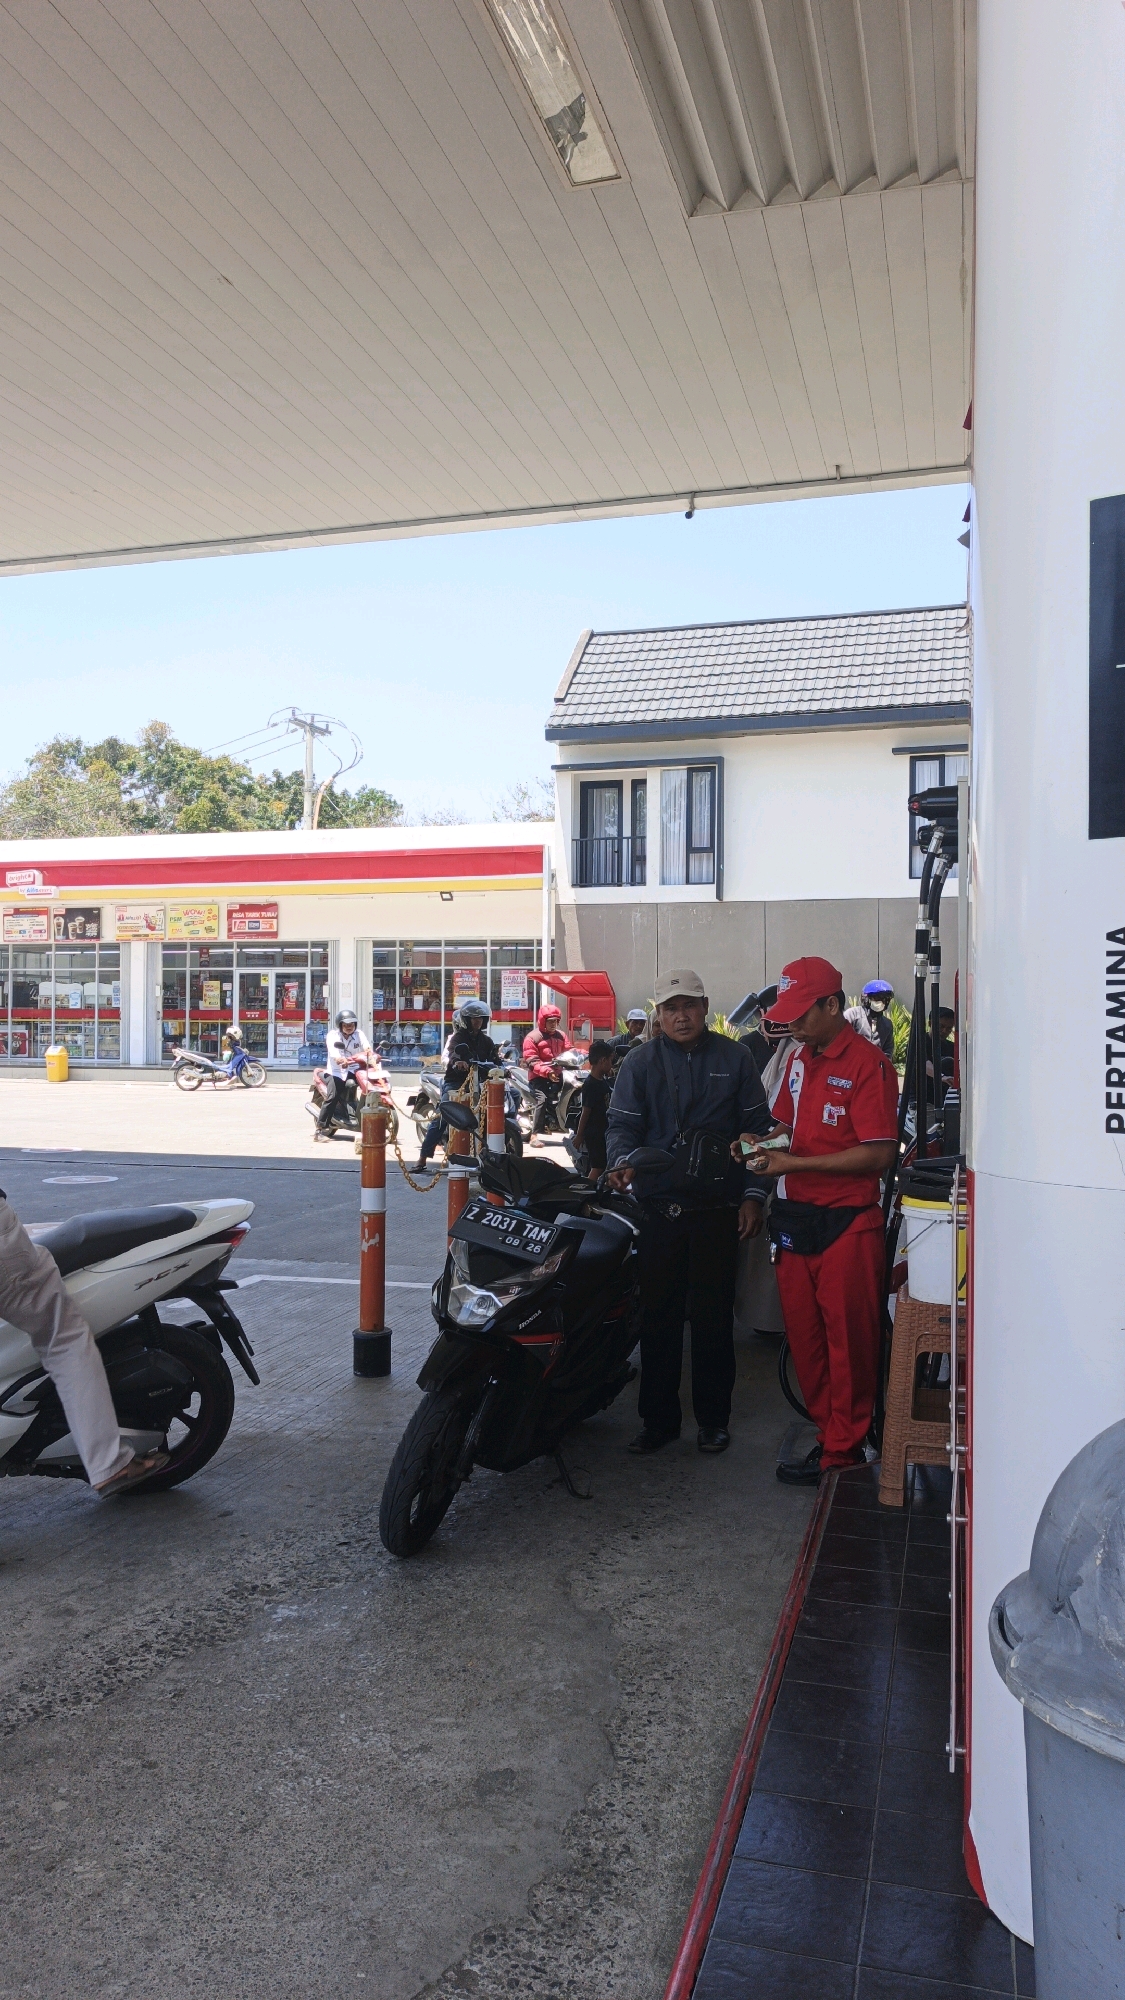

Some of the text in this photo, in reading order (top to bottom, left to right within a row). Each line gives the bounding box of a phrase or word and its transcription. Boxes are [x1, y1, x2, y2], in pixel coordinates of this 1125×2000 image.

[1105, 926, 1125, 1134] PERTAMINA
[466, 1207, 551, 1243] Z 2031 TAM
[505, 1236, 542, 1253] 09 26
[133, 1258, 193, 1291] PCX
[518, 1309, 542, 1331] HONDA
